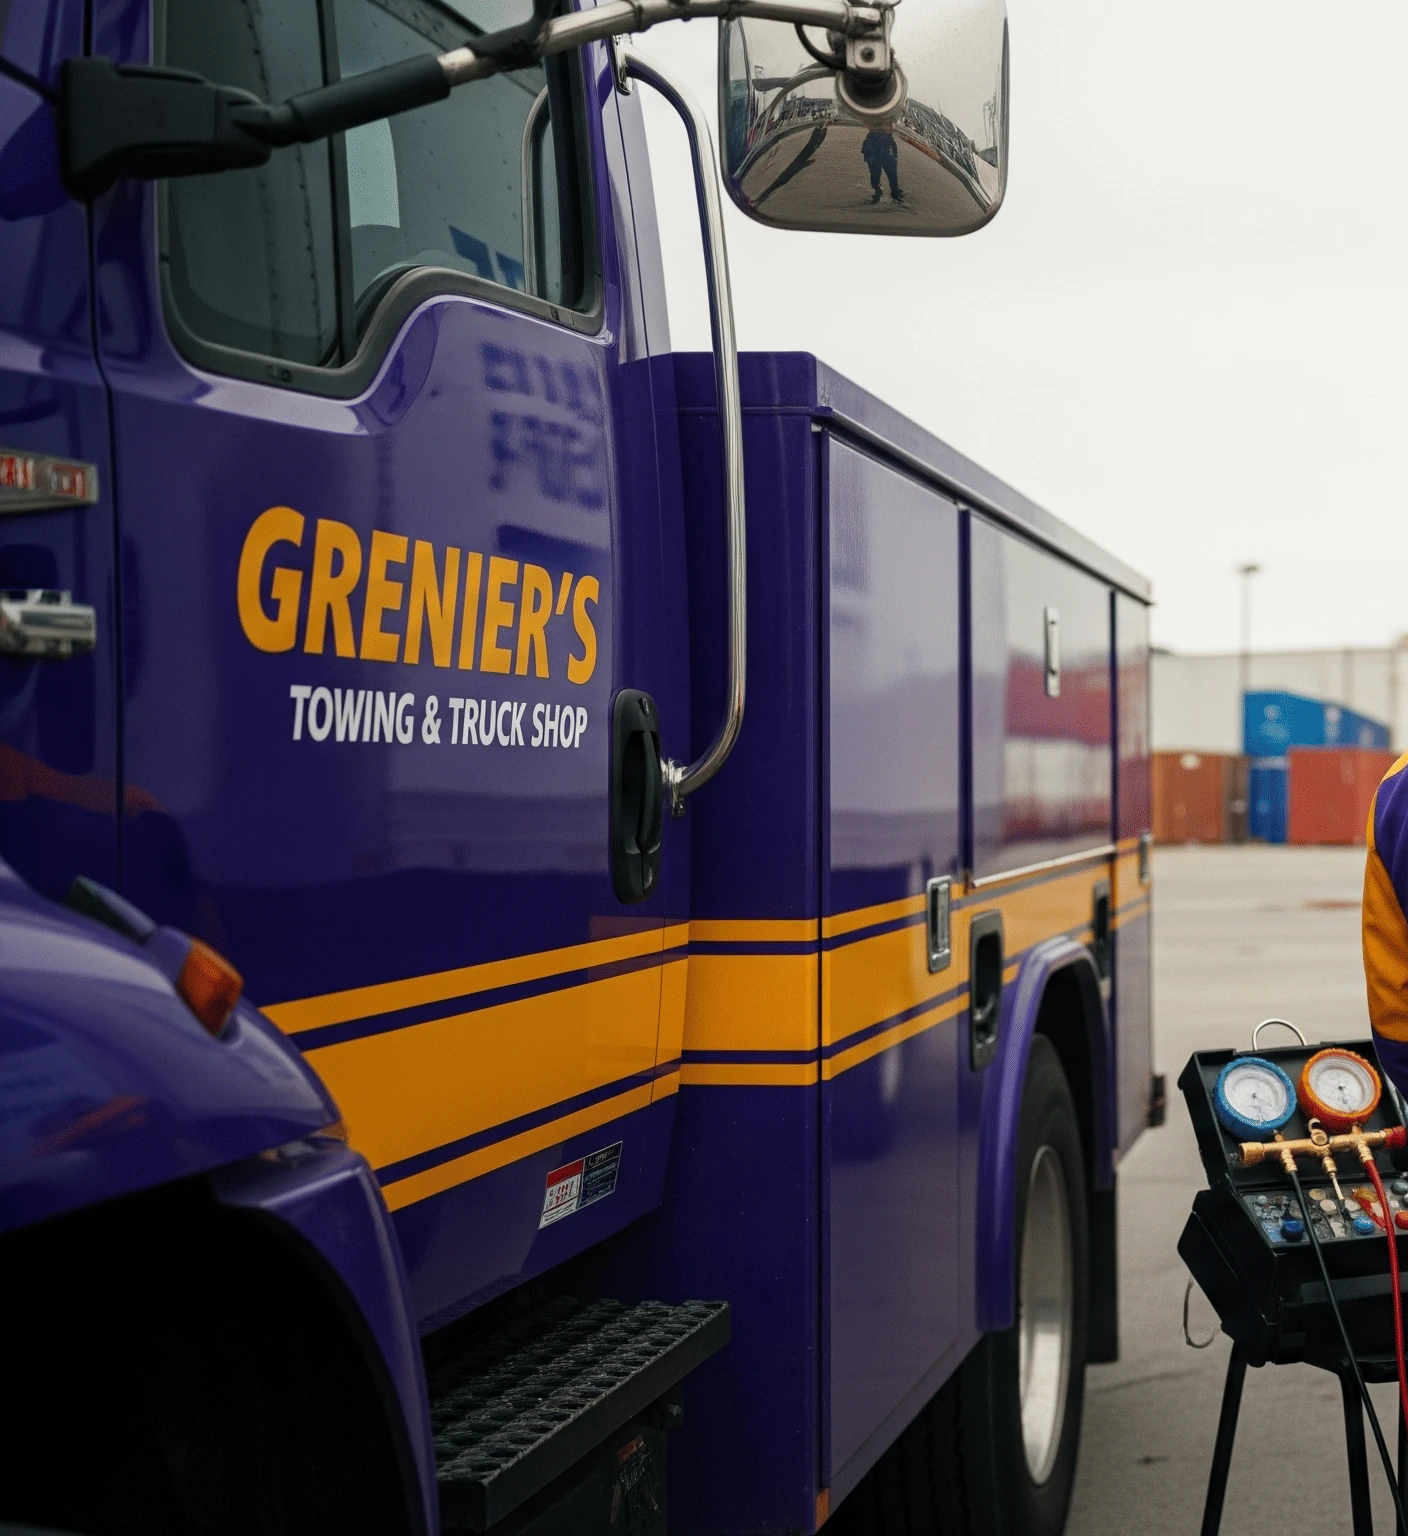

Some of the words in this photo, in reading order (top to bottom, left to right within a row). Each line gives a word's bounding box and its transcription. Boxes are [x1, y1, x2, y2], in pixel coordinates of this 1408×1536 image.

[236, 506, 600, 685] GRENIER'S
[289, 684, 415, 742] TOWING
[421, 694, 443, 744] &
[448, 697, 527, 746] TRUCK
[530, 703, 588, 749] SHOP
